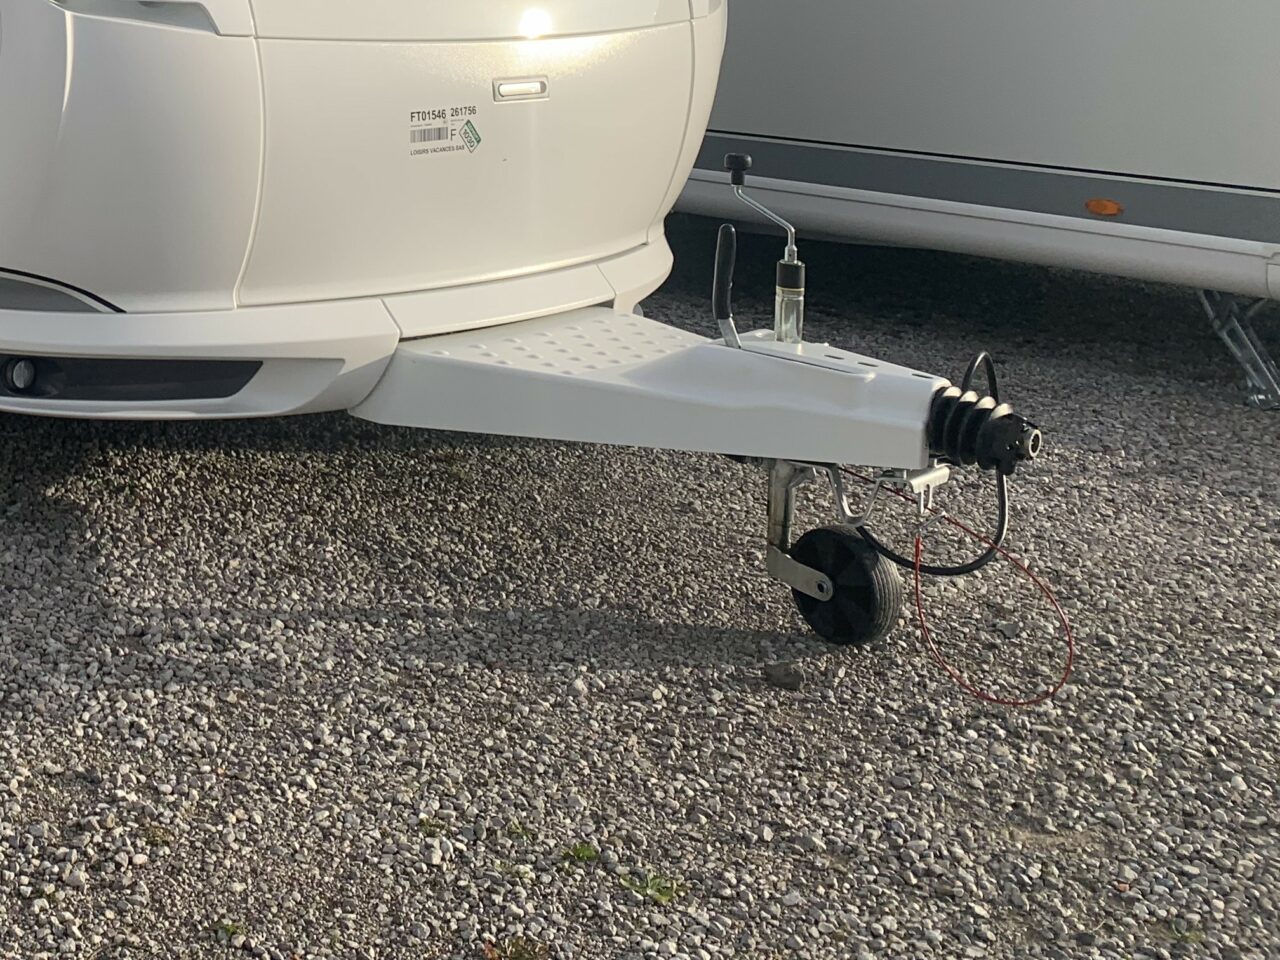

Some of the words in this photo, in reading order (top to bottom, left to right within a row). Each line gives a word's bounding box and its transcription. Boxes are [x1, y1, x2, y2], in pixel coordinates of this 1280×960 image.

[410, 110, 446, 122] FT01546
[451, 106, 476, 116] 261756
[451, 129, 456, 140] F
[463, 129, 475, 147] 1030
[430, 145, 455, 154] VACANCES
